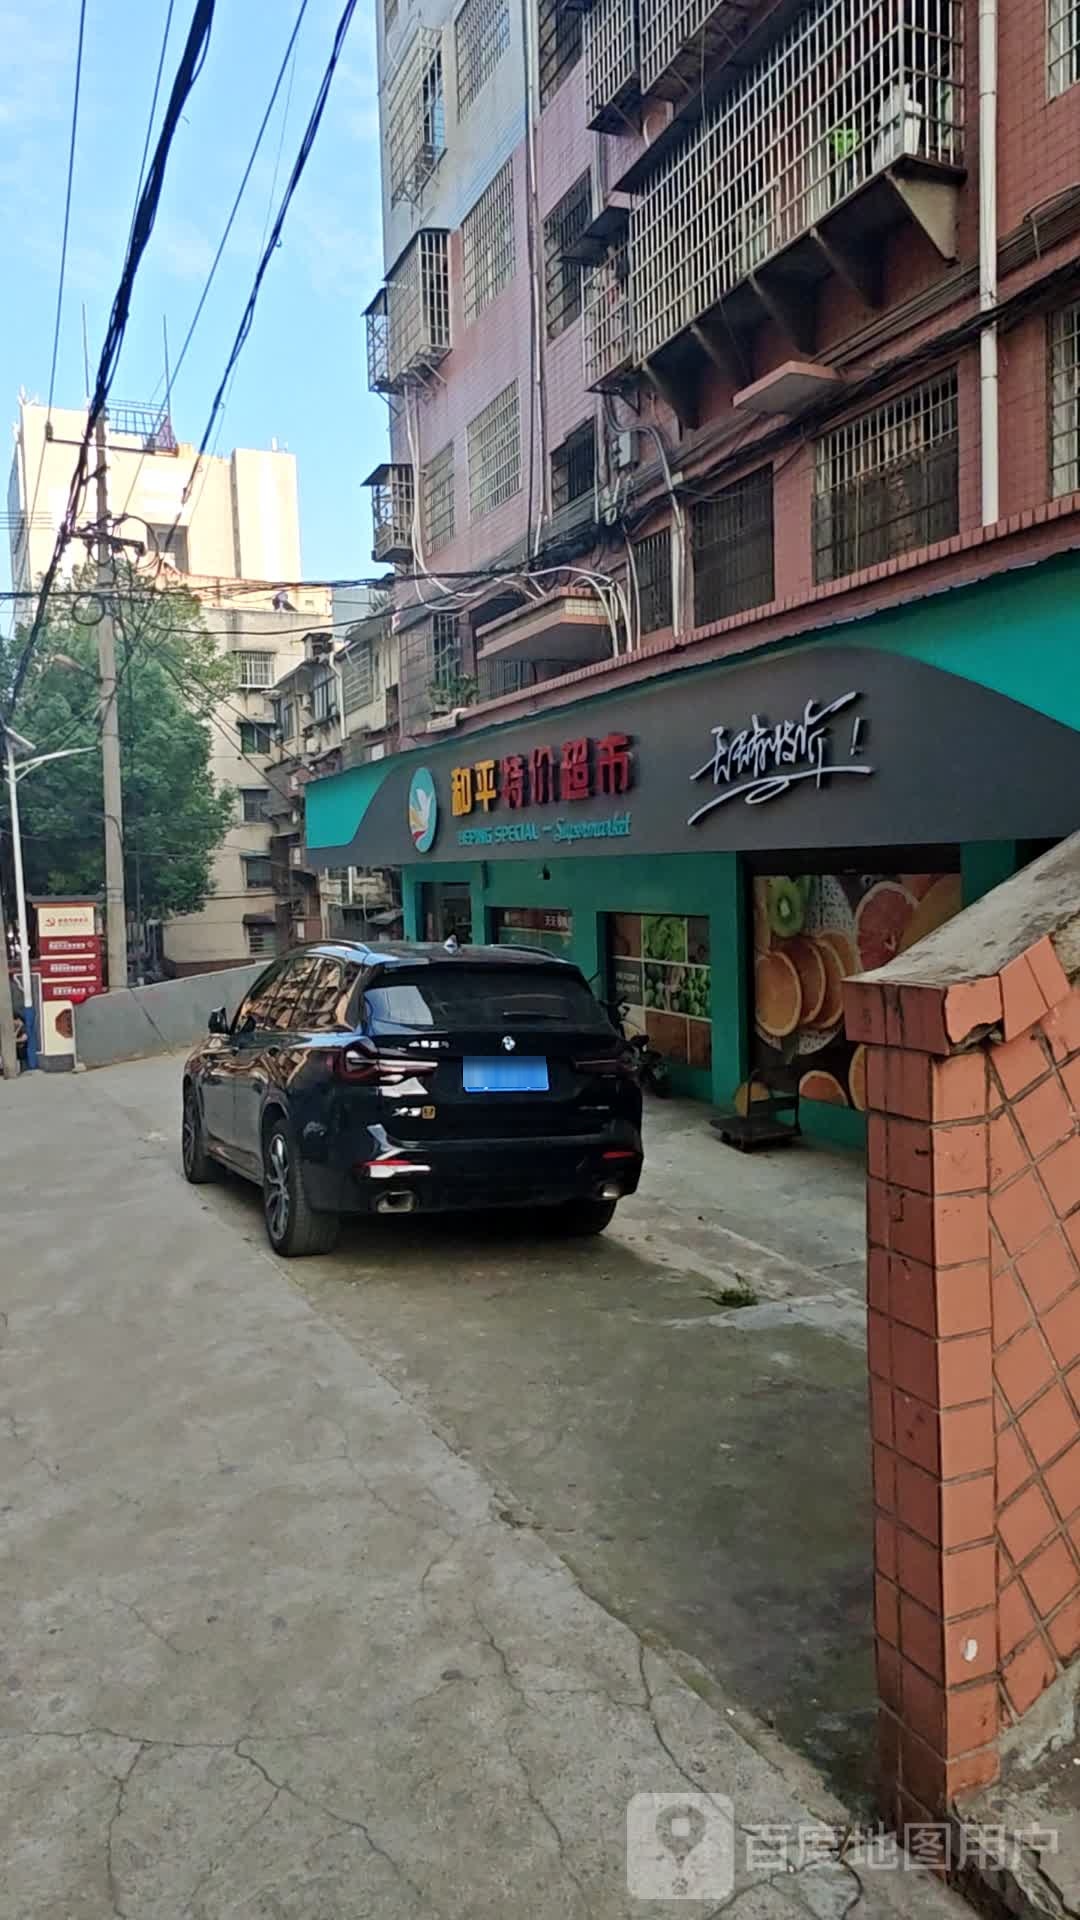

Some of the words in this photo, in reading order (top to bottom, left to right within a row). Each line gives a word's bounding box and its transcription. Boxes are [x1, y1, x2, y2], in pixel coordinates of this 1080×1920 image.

[450, 732, 632, 817] 和平特价超市
